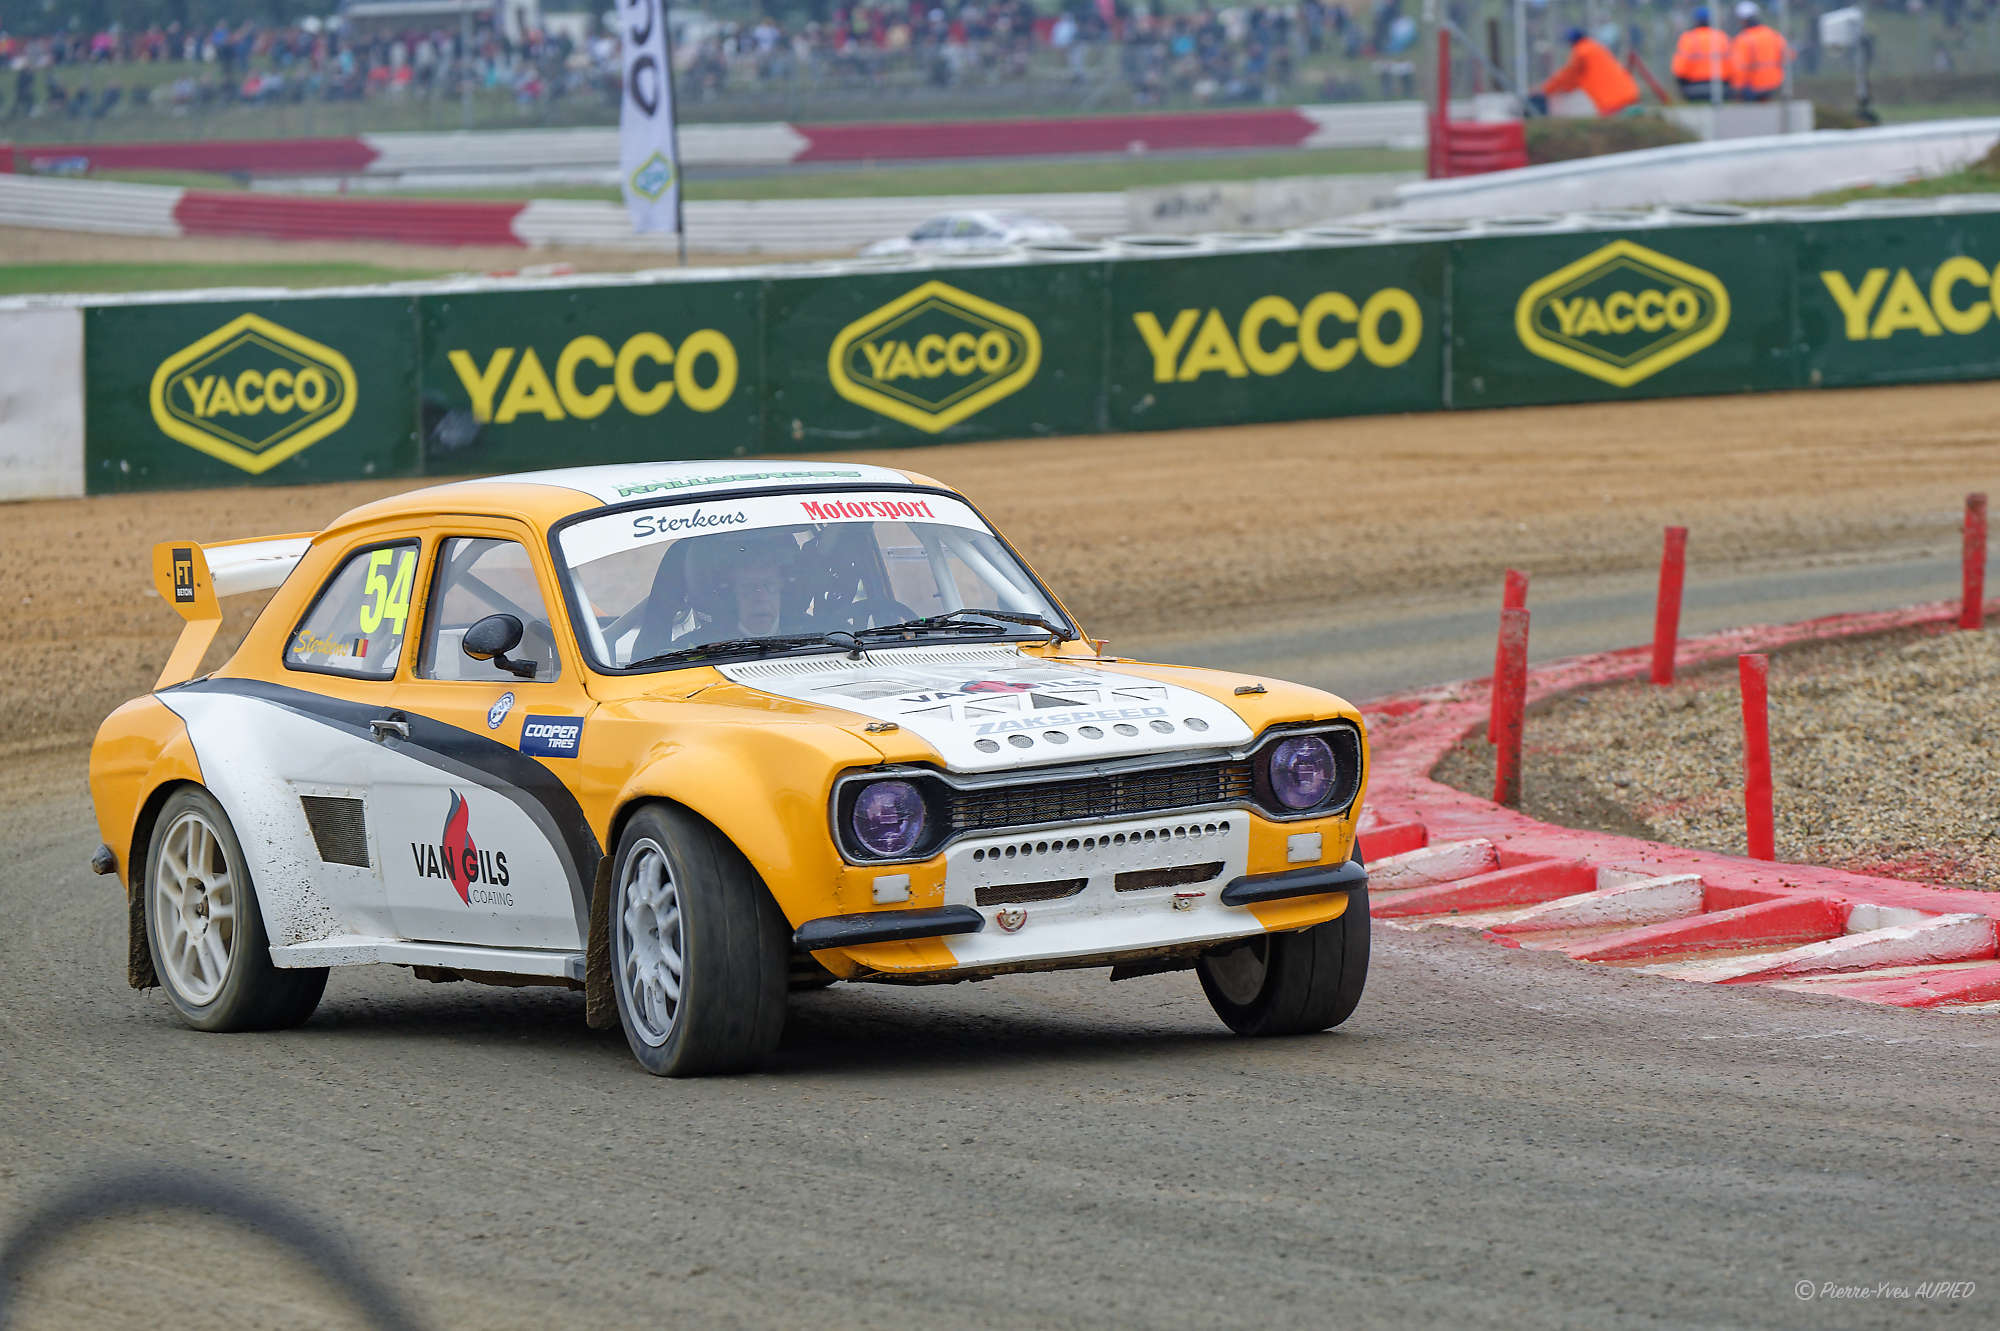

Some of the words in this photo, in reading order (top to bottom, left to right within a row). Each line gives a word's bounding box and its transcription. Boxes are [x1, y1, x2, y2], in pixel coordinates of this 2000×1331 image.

[1548, 287, 1699, 337] YACCO
[861, 330, 1011, 380] YACCO
[1133, 287, 1422, 383] YACCO
[182, 367, 327, 418] YACCO
[448, 329, 739, 424] YACCO
[632, 508, 748, 538] Sterkens
[800, 499, 936, 520] Motorsport
[175, 560, 192, 585] FT
[360, 548, 416, 635] 54
[524, 723, 580, 739] COOPER
[972, 706, 1166, 735] ZAKSPEED
[548, 738, 576, 749] TIRES
[411, 842, 457, 881] VAN
[461, 847, 510, 887] GILS
[472, 889, 514, 907] COATING
